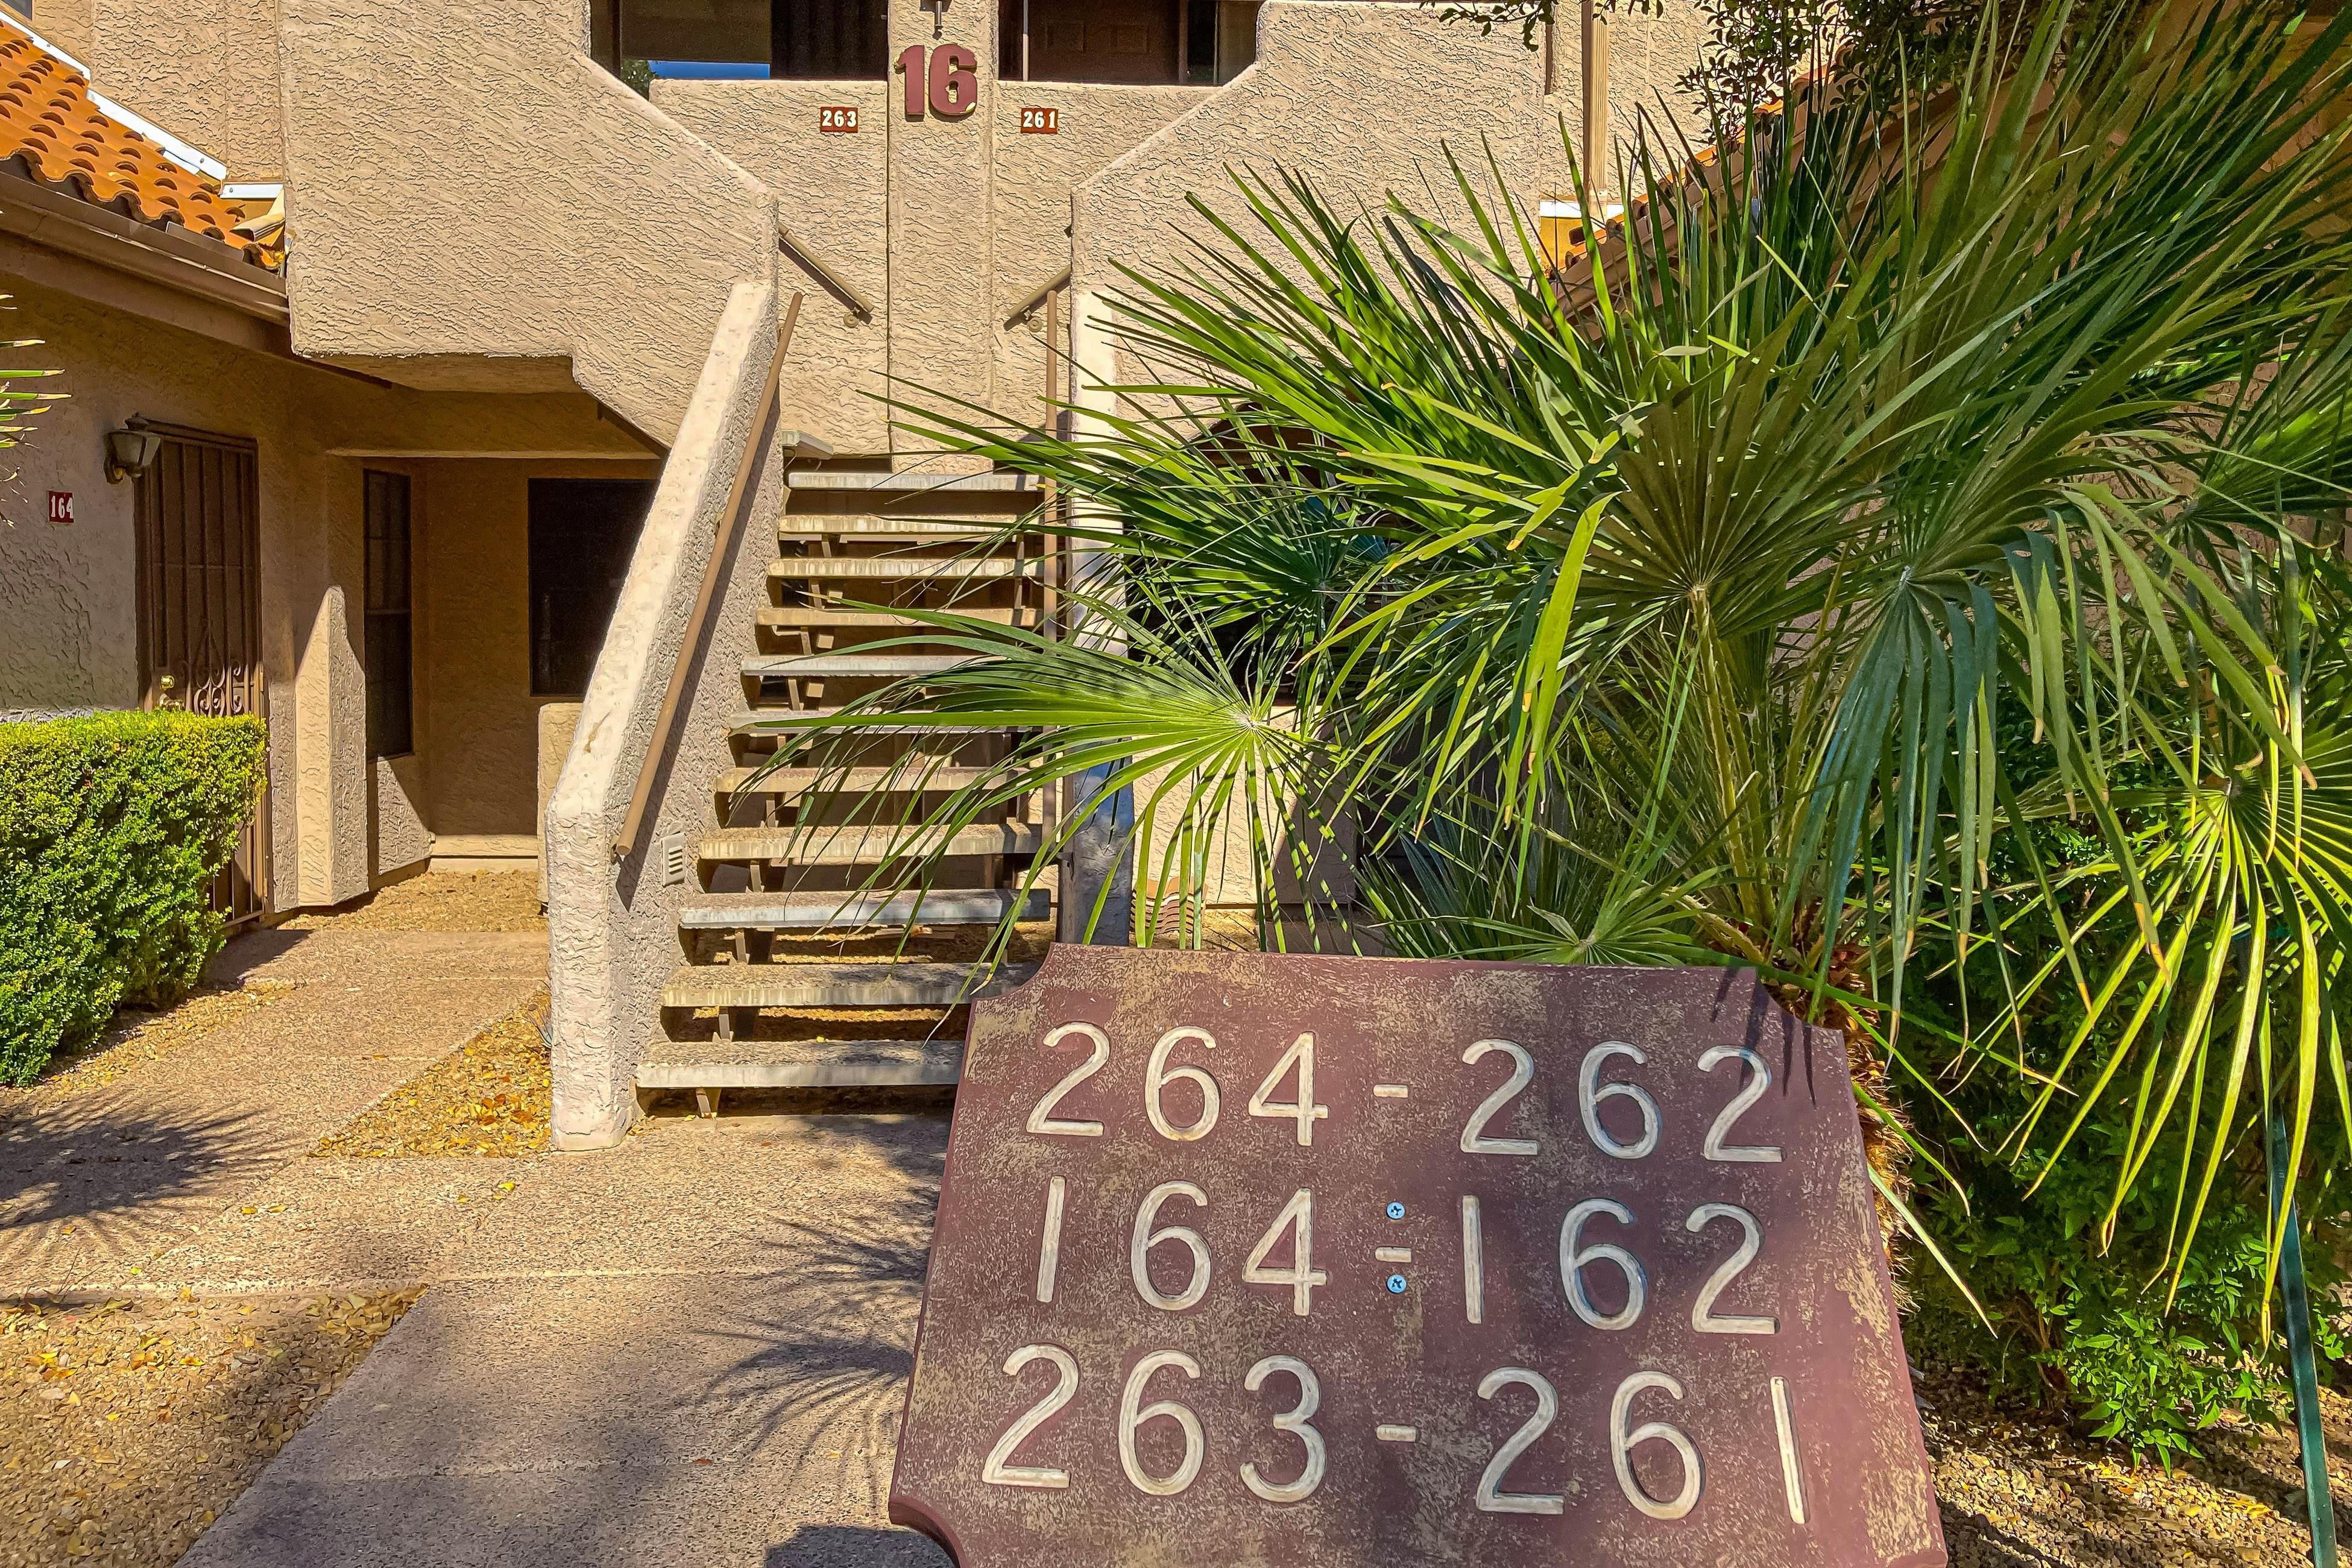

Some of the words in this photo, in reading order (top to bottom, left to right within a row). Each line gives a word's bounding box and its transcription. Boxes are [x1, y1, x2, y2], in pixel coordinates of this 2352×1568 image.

[894, 43, 978, 116] 16
[821, 110, 857, 127] 263
[1023, 110, 1057, 128] 261
[51, 496, 74, 518] 164
